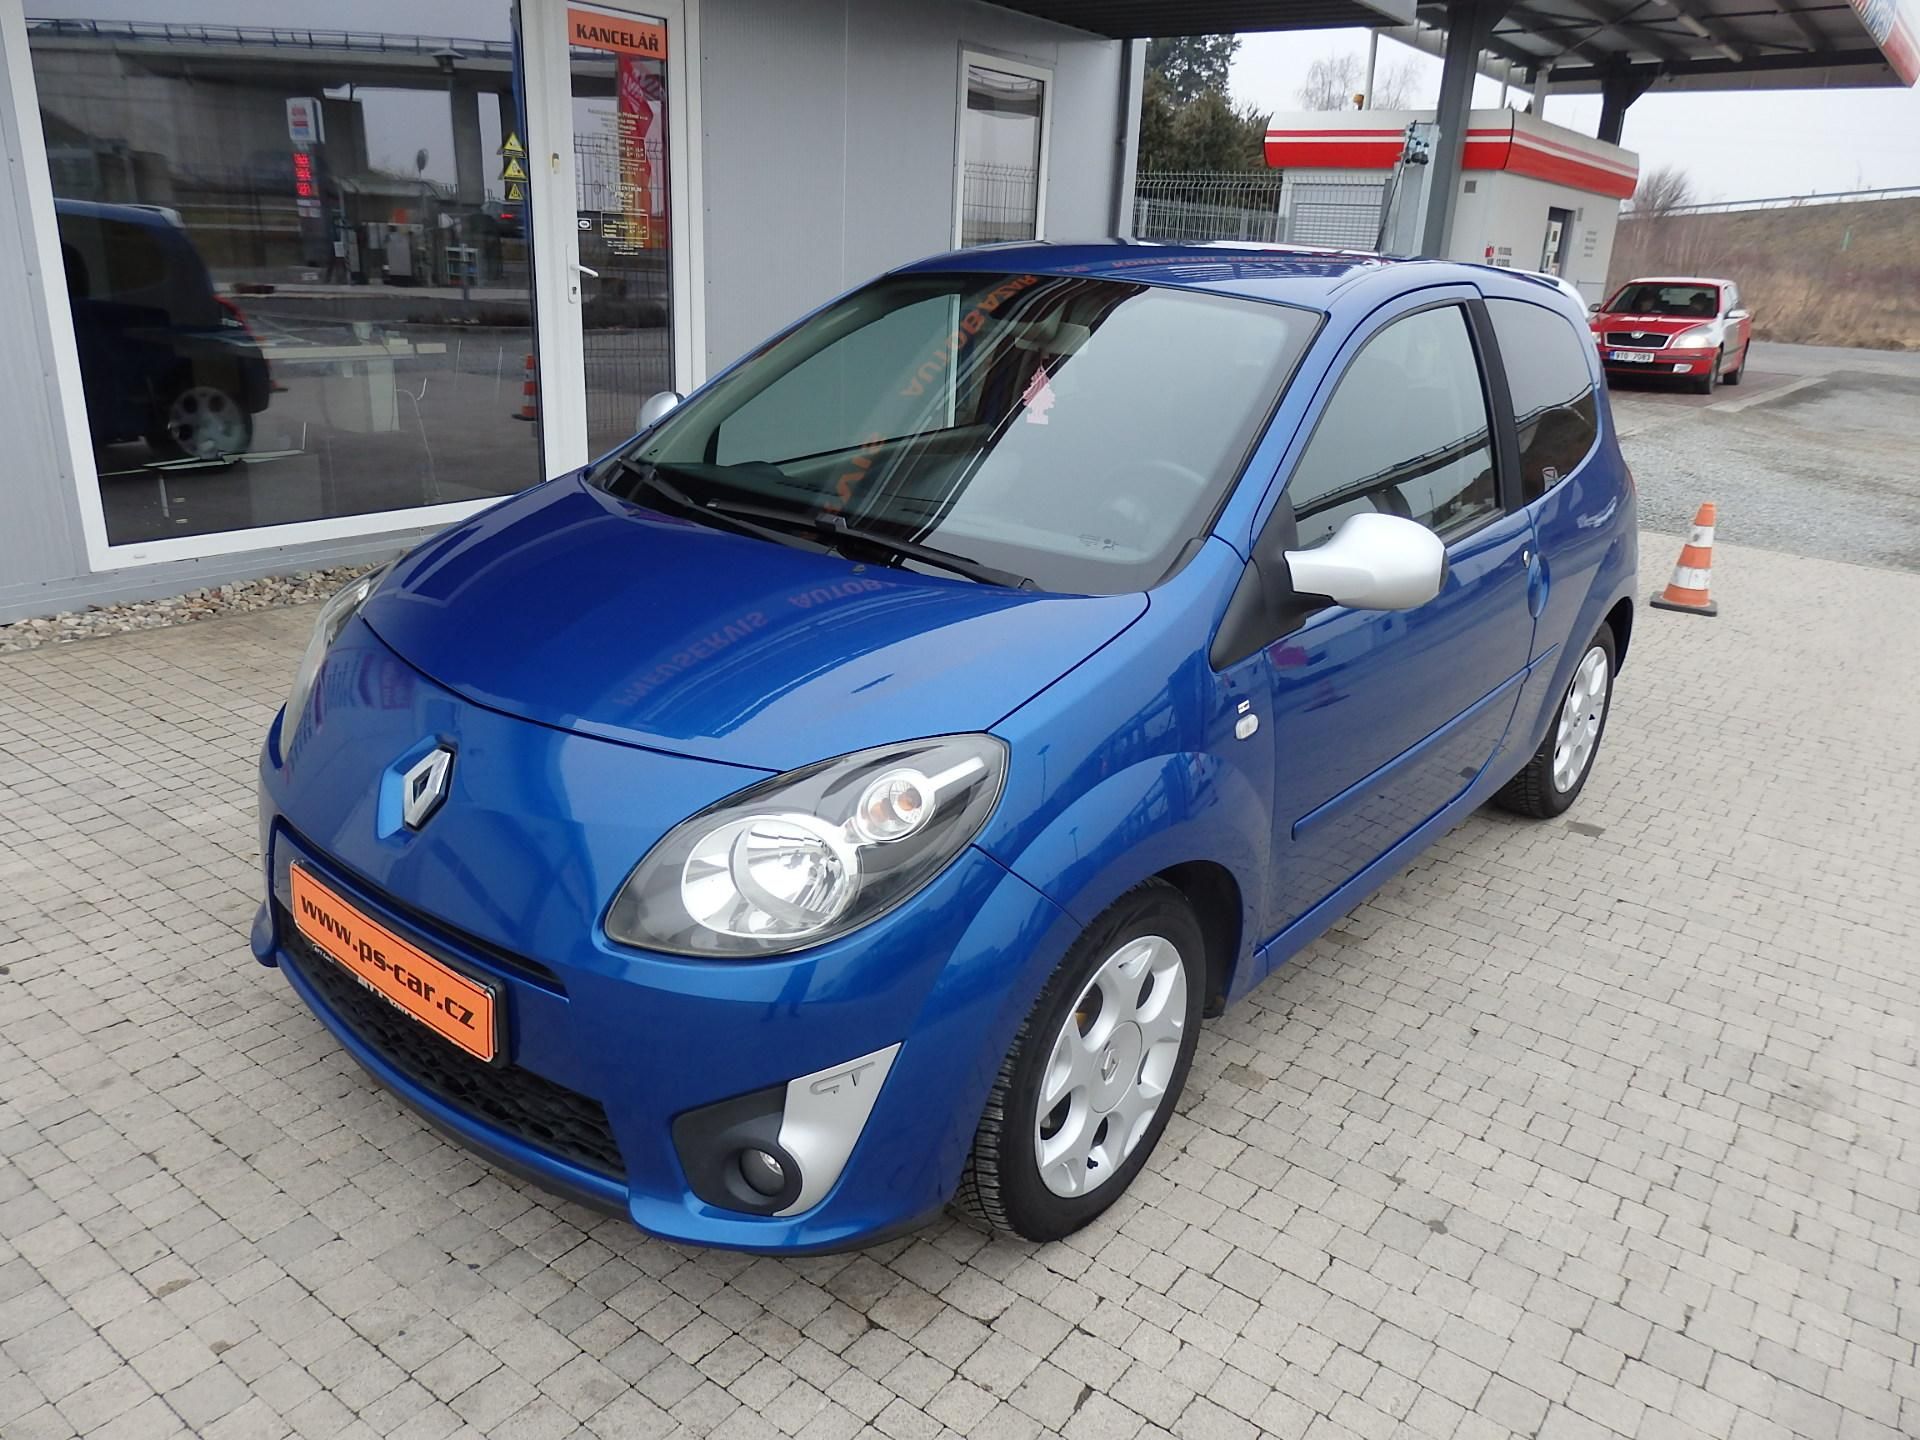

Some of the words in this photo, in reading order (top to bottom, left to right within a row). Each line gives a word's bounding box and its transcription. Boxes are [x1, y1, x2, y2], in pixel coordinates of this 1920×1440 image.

[576, 22, 659, 51] KANCELÁŘ
[300, 895, 476, 1031] www.ps-car.cz
[808, 1060, 877, 1096] GT
